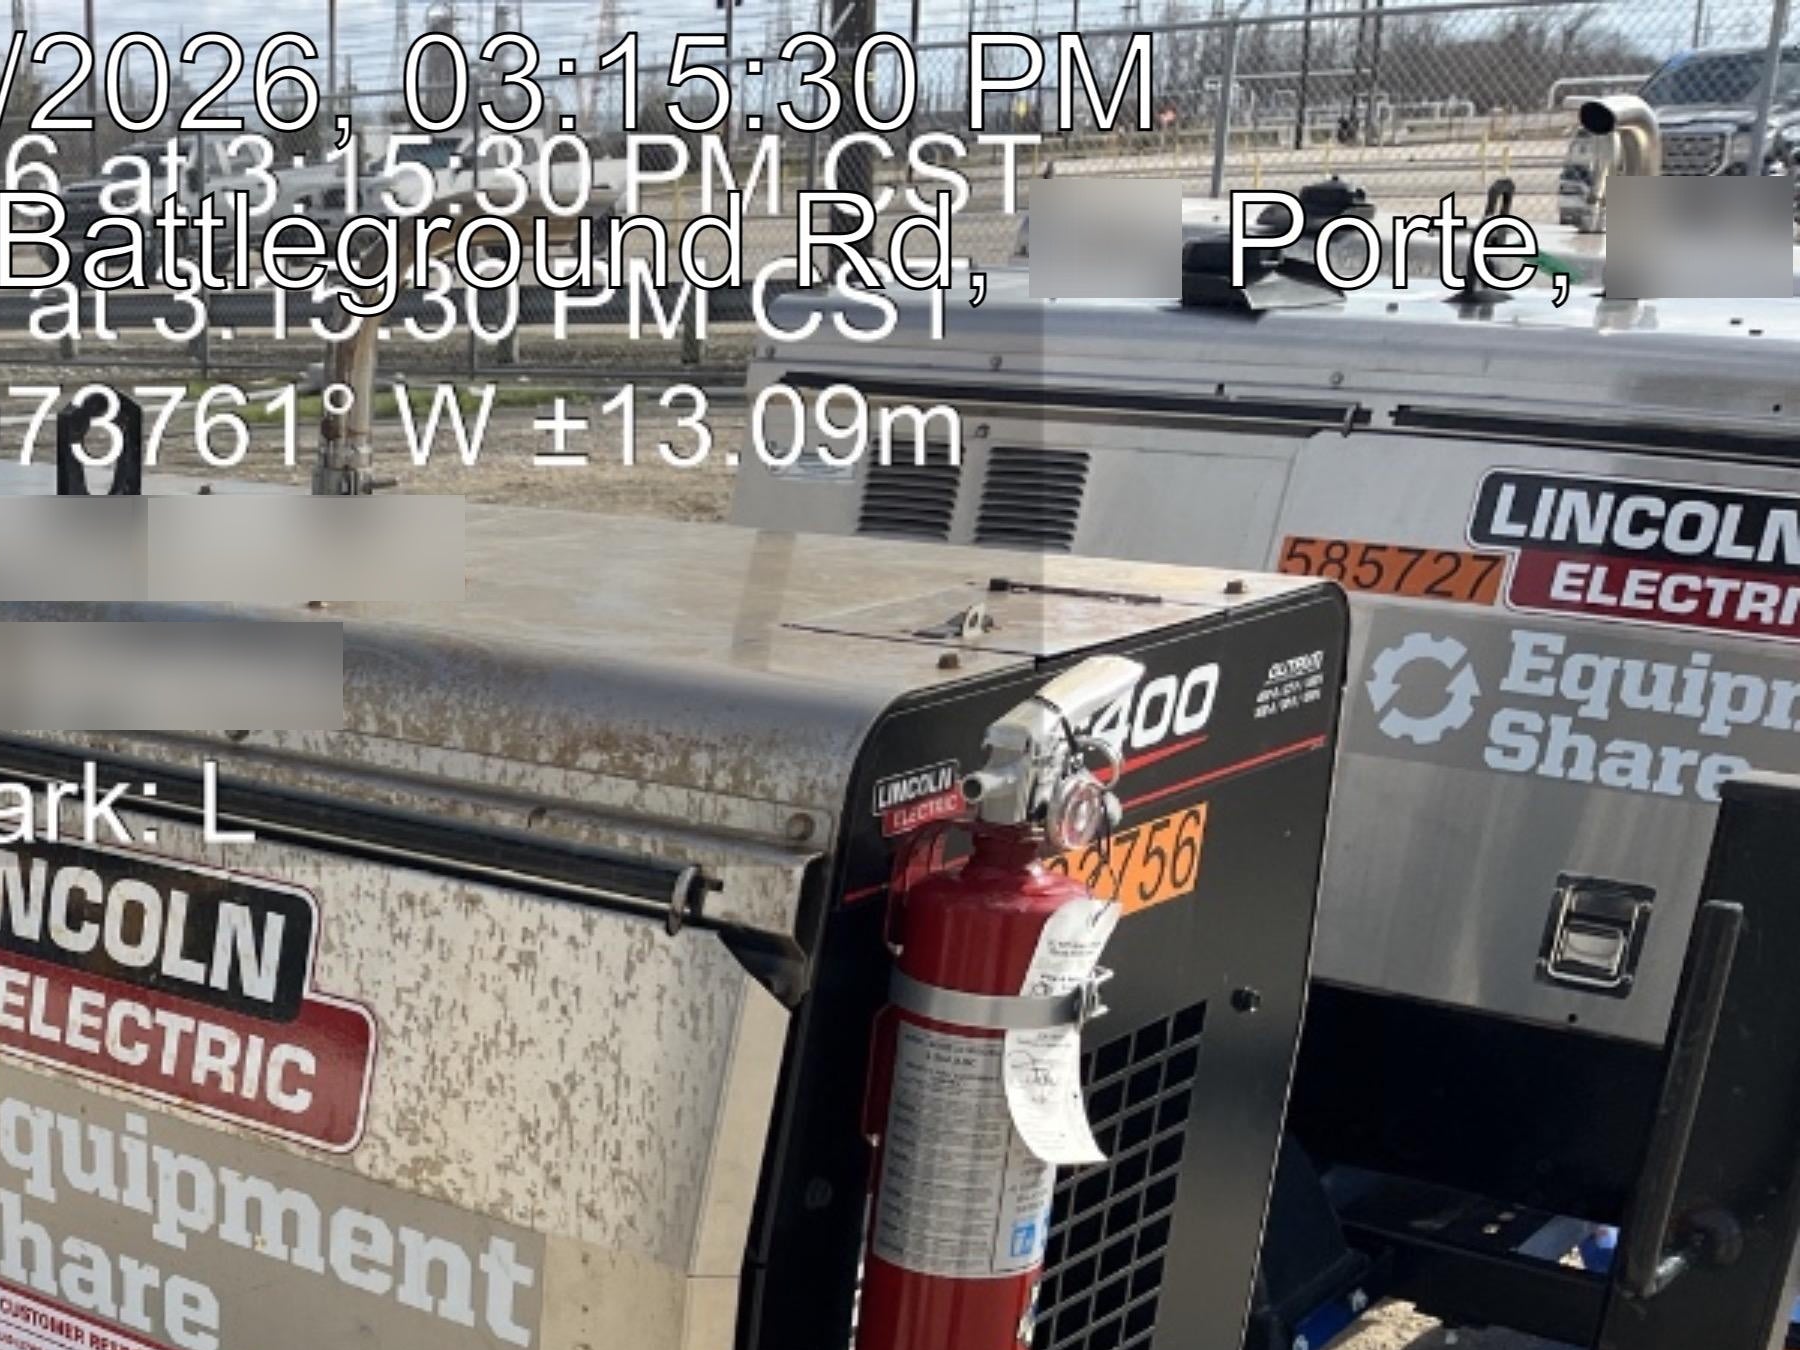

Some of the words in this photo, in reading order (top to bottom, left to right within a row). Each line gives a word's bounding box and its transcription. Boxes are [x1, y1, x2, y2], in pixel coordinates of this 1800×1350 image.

[1489, 483, 1800, 566] LINCOLN
[1285, 538, 1500, 599] 585727
[1550, 559, 1800, 626] ELECTRI
[1091, 662, 1220, 757] 400
[878, 766, 954, 810] LINCOLN
[892, 793, 959, 828] ELECTRIC
[0, 1296, 85, 1345] CUSTOMER
